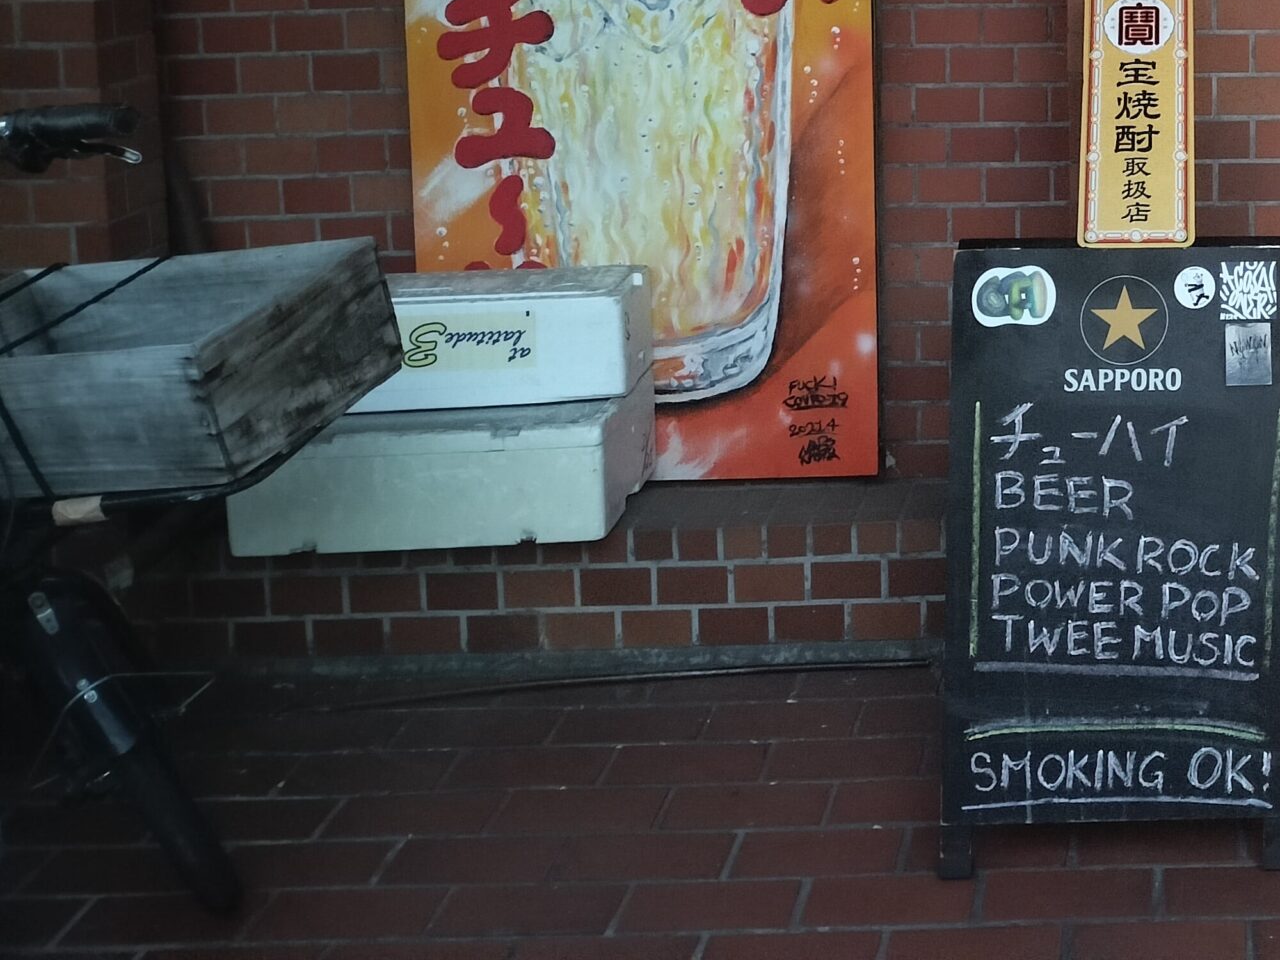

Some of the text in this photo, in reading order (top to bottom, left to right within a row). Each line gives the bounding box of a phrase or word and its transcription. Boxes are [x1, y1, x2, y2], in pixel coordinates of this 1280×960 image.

[444, 329, 526, 349] latitude
[507, 348, 531, 363] at
[1063, 368, 1182, 392] SAPPORO
[990, 402, 1189, 467] チューハイ
[994, 470, 1134, 520] BEER
[993, 525, 1260, 580] PUNK ROCK
[991, 573, 1251, 626] POWER POP
[991, 614, 1257, 667] TWEE MUSIC
[970, 746, 1272, 793] SMOKING OK!
